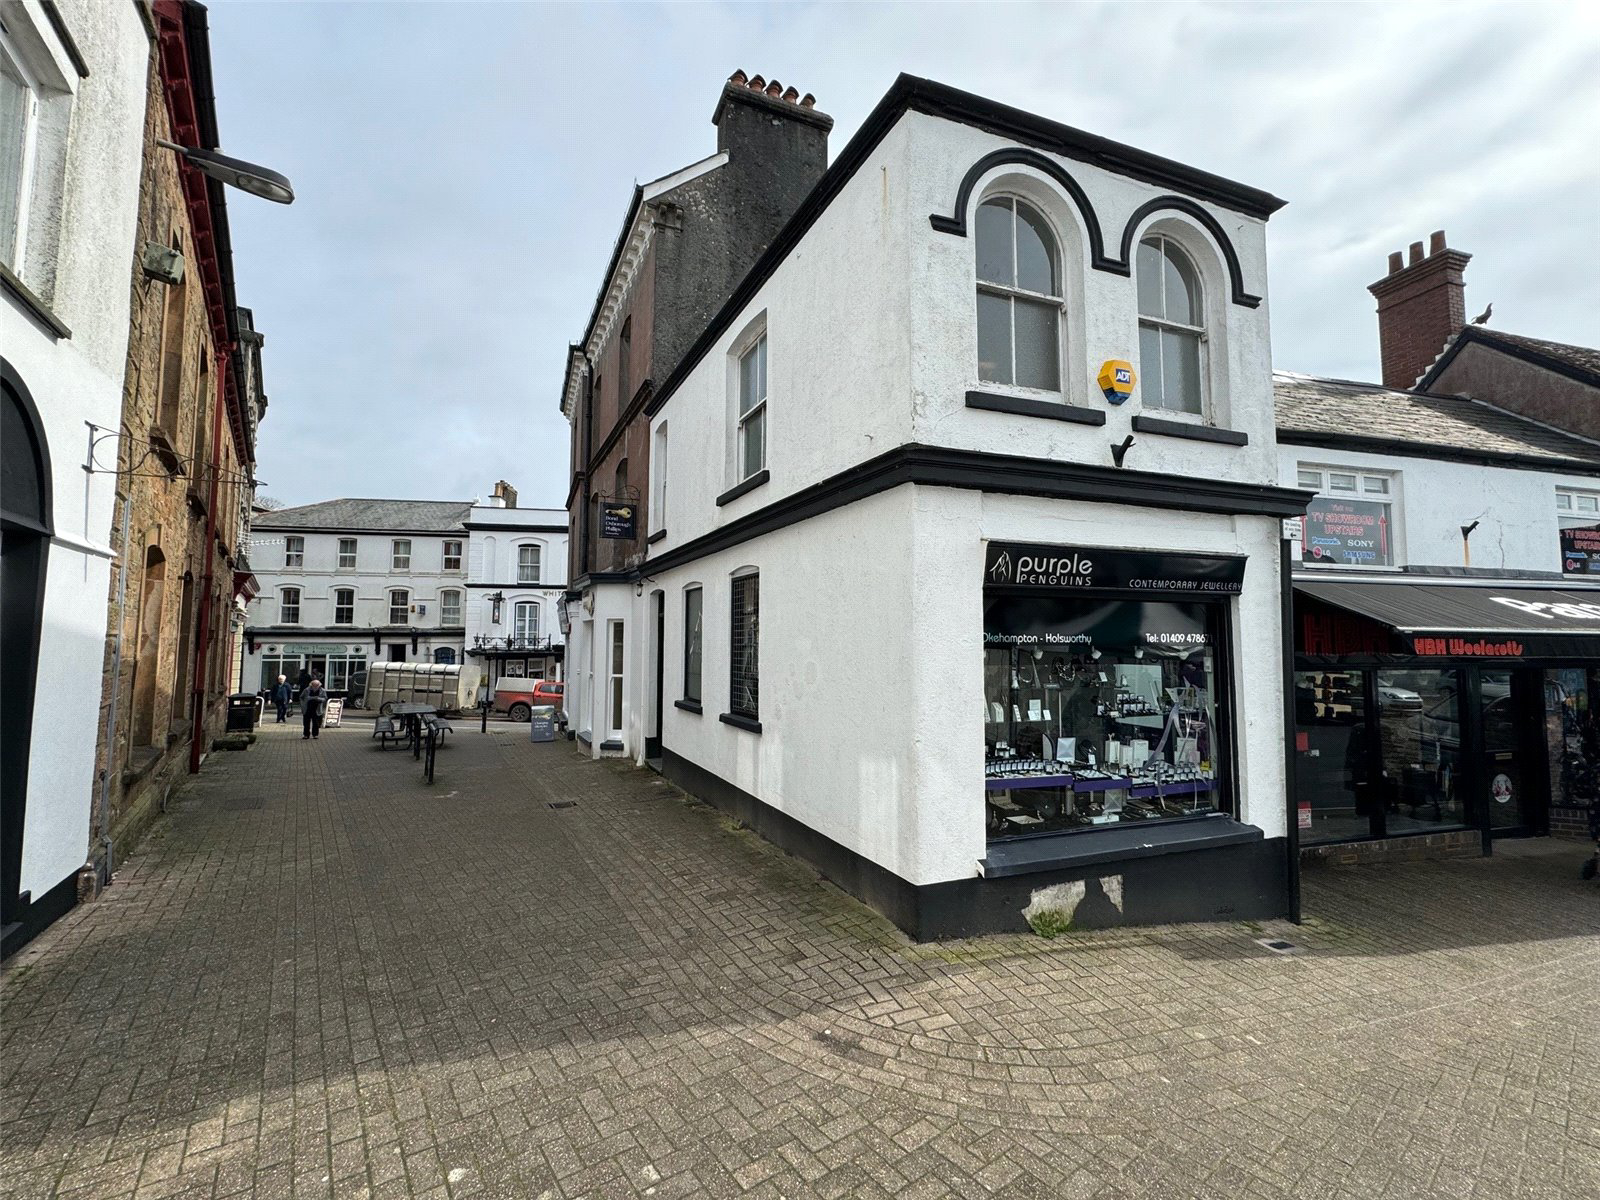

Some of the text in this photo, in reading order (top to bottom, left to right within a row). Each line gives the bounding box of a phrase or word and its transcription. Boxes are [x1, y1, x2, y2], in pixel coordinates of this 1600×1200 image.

[1116, 371, 1130, 382] ADT
[1312, 512, 1374, 526] TV SHOWROOM
[1324, 525, 1364, 536] UPSTAIRS
[1347, 540, 1374, 548] SONY
[1343, 551, 1376, 559] SAMSUNG
[1016, 553, 1093, 584] purple
[1020, 574, 1092, 586] PENGUINS
[1129, 579, 1241, 591] CONTEMPORARY JEWELLERY
[983, 632, 1038, 645] Okehampton
[1045, 633, 1092, 645] Holsworthy
[1145, 633, 1159, 643] Tel:
[1160, 633, 1185, 643] 01409
[1413, 638, 1523, 657] HBH Woolacotts
